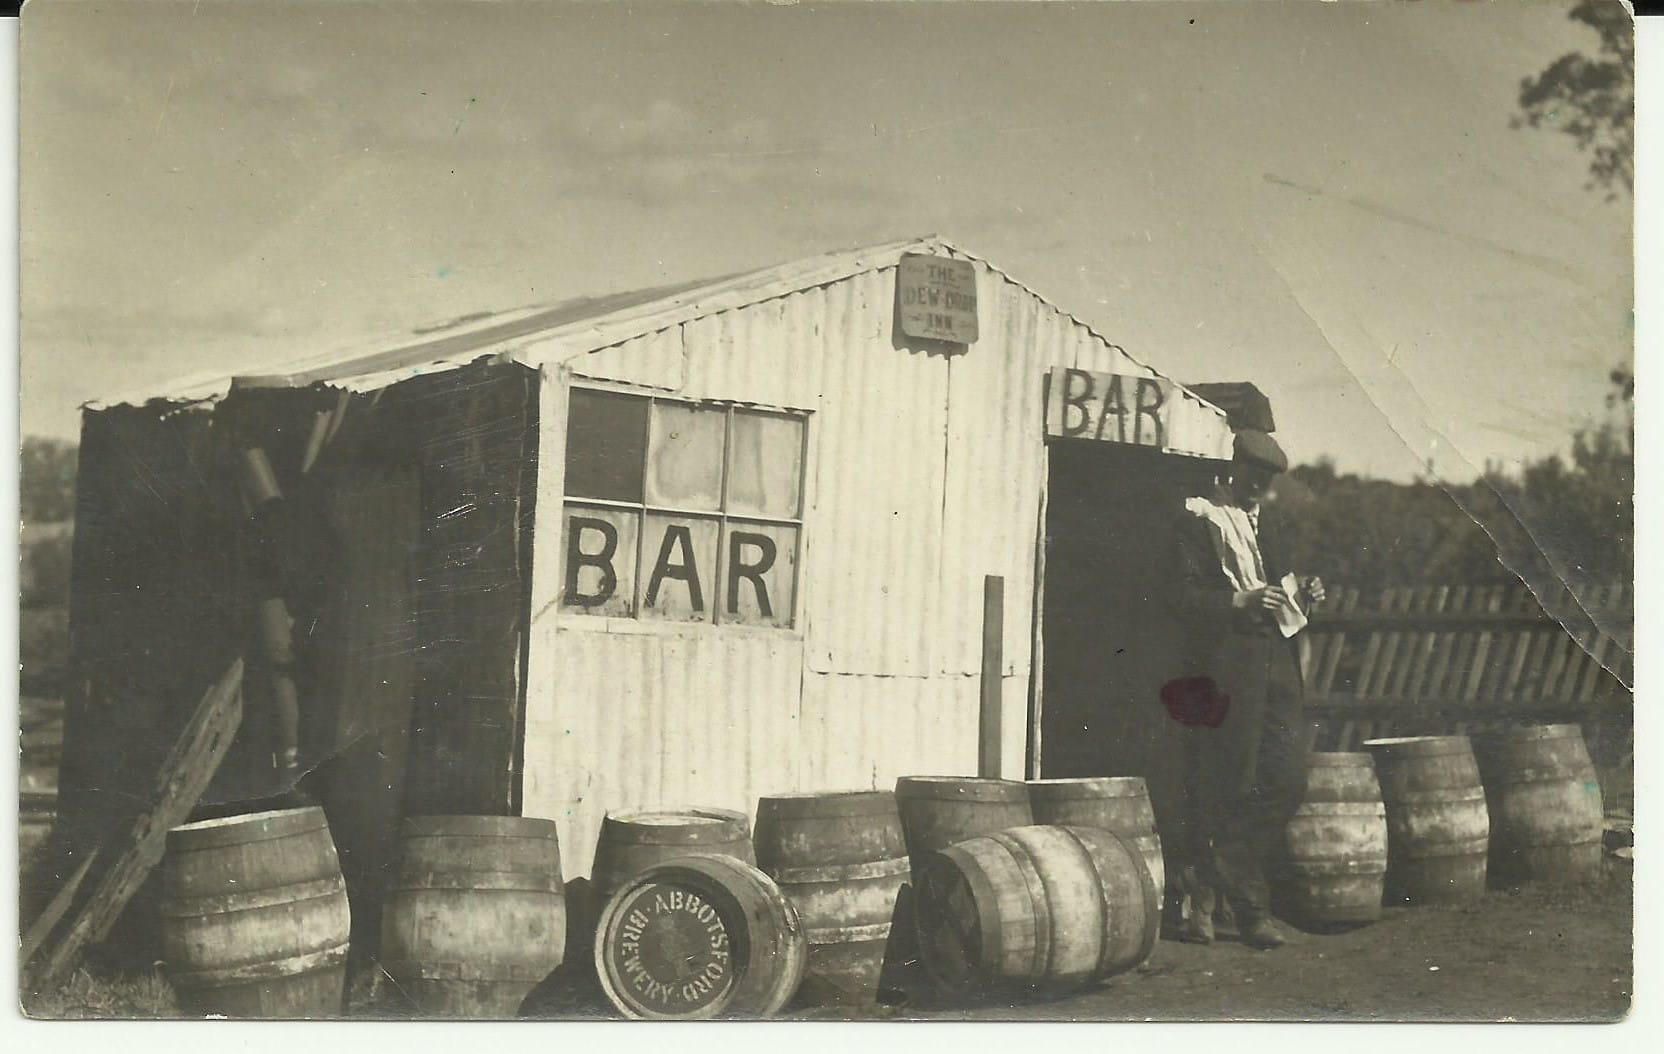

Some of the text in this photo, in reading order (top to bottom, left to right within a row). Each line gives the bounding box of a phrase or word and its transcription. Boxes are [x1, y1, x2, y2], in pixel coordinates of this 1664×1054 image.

[903, 286, 941, 307] DEW
[926, 264, 957, 282] THE
[927, 312, 953, 330] INN
[1061, 367, 1164, 447] BAR
[563, 515, 777, 617] BAR
[621, 891, 730, 1002] ABBOTSFORD BREWERY
